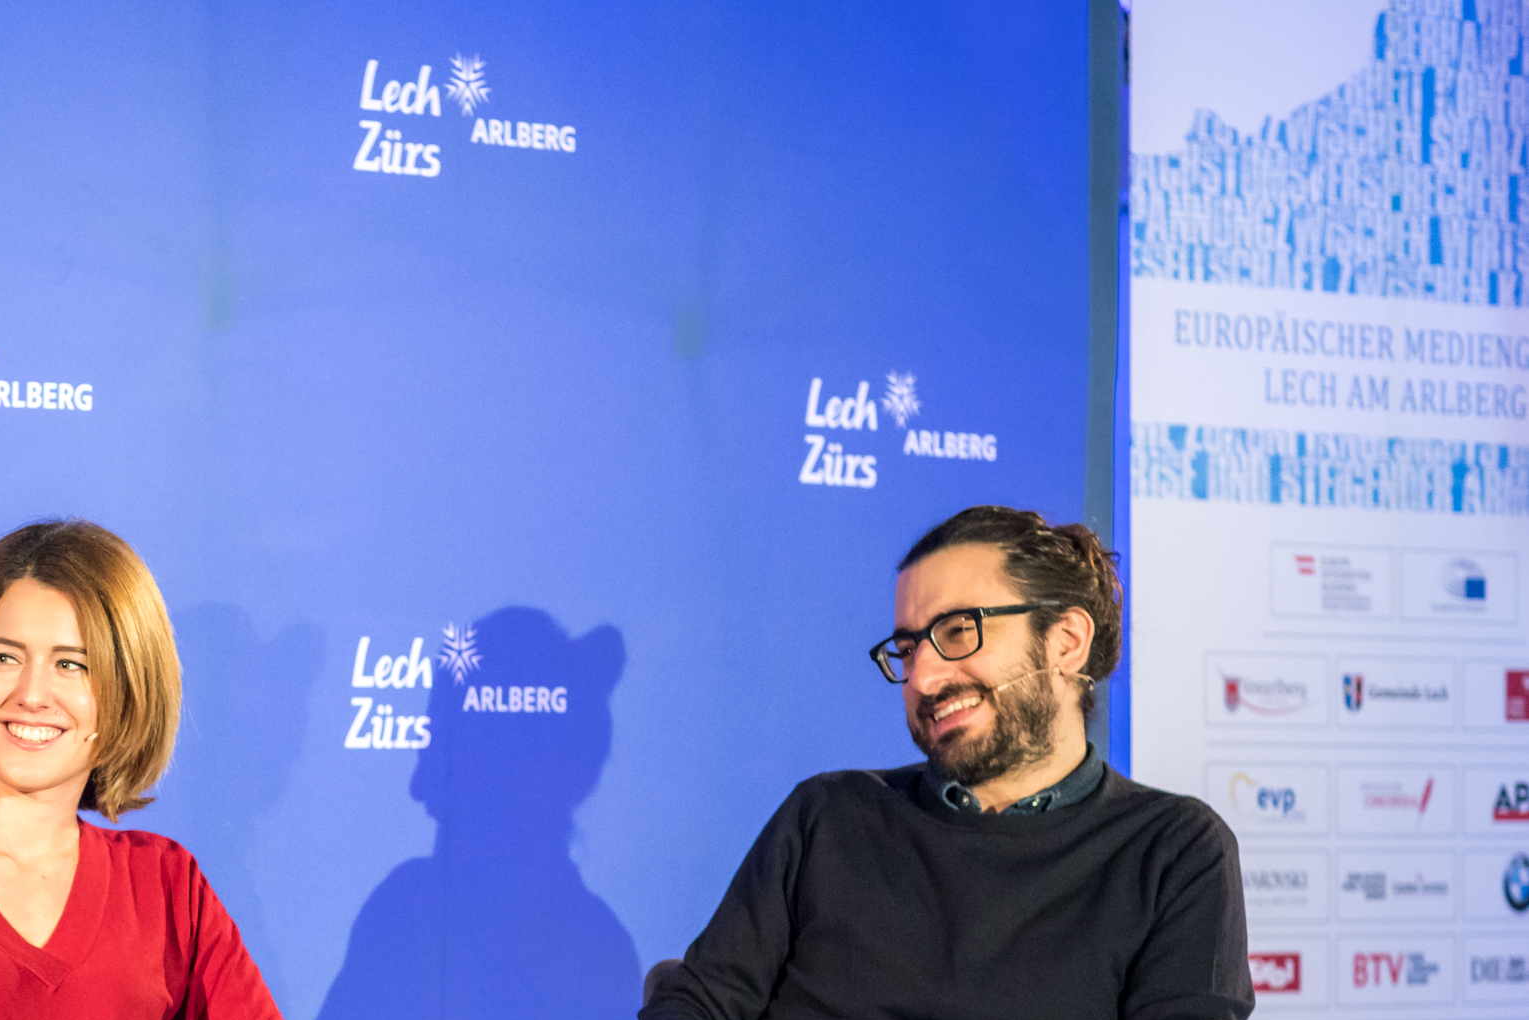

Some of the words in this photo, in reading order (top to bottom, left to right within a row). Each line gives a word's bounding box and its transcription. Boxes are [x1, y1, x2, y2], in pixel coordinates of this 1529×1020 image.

[359, 58, 442, 117] Lech
[352, 120, 442, 178] Zürs
[471, 117, 576, 153] ARLBERG
[1174, 309, 1396, 362] EUROPÄISCHER
[805, 377, 878, 431] Lech
[1263, 368, 1337, 407] LECH
[1347, 374, 1391, 412] AM
[1400, 377, 1529, 420] ARLBERG
[798, 434, 878, 489] Zürs
[903, 429, 997, 462] ARLBERG
[351, 636, 433, 690] Lech
[343, 697, 432, 750] Zürs
[462, 685, 568, 714] ARLBERG
[1256, 786, 1296, 813] evp
[1353, 952, 1405, 988] BTV
